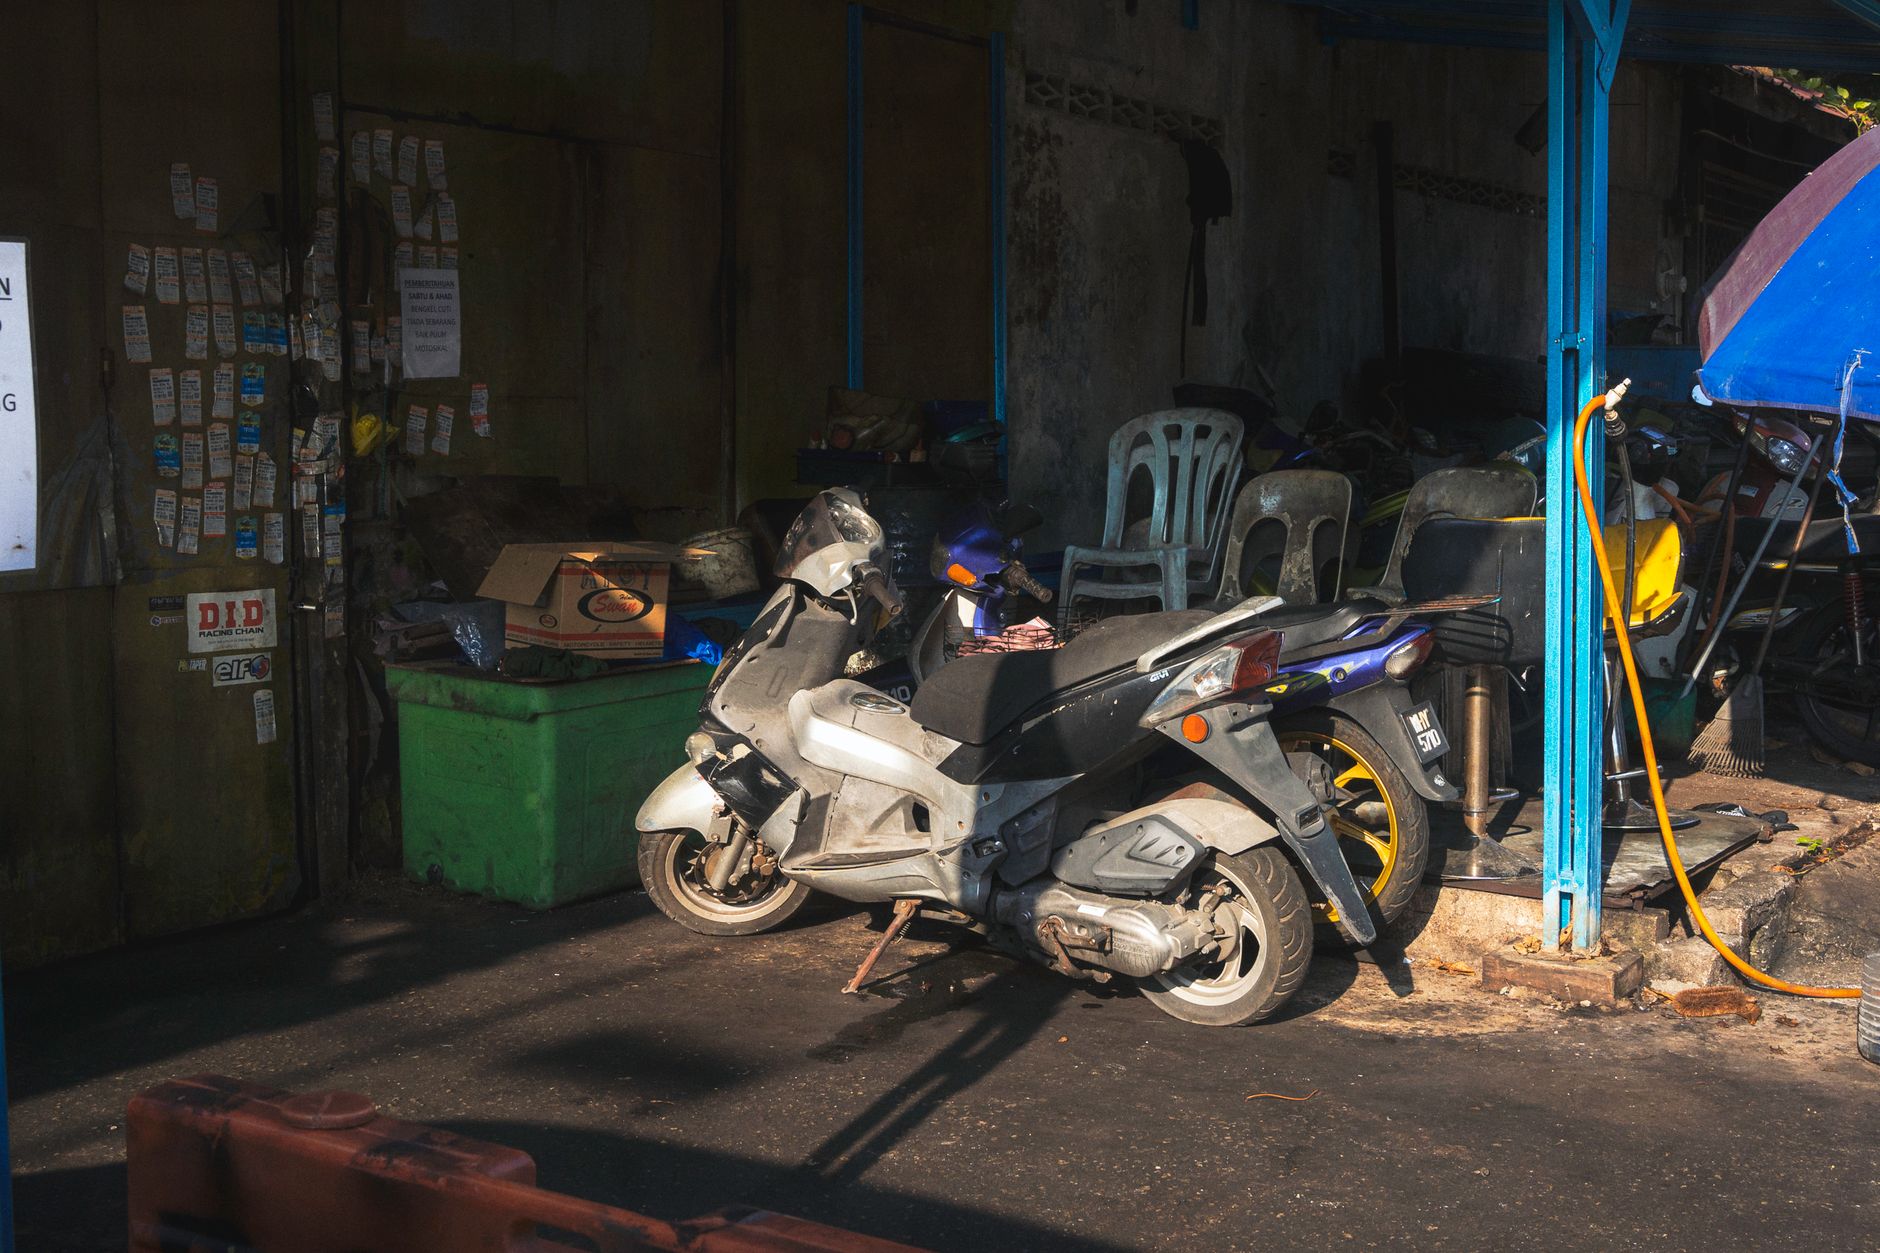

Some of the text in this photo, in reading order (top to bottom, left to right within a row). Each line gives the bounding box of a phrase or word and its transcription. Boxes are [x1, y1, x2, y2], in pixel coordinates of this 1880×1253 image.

[199, 626, 264, 638] RACING CHAIN
[215, 659, 251, 682] elf
[1149, 669, 1170, 683] GIVI
